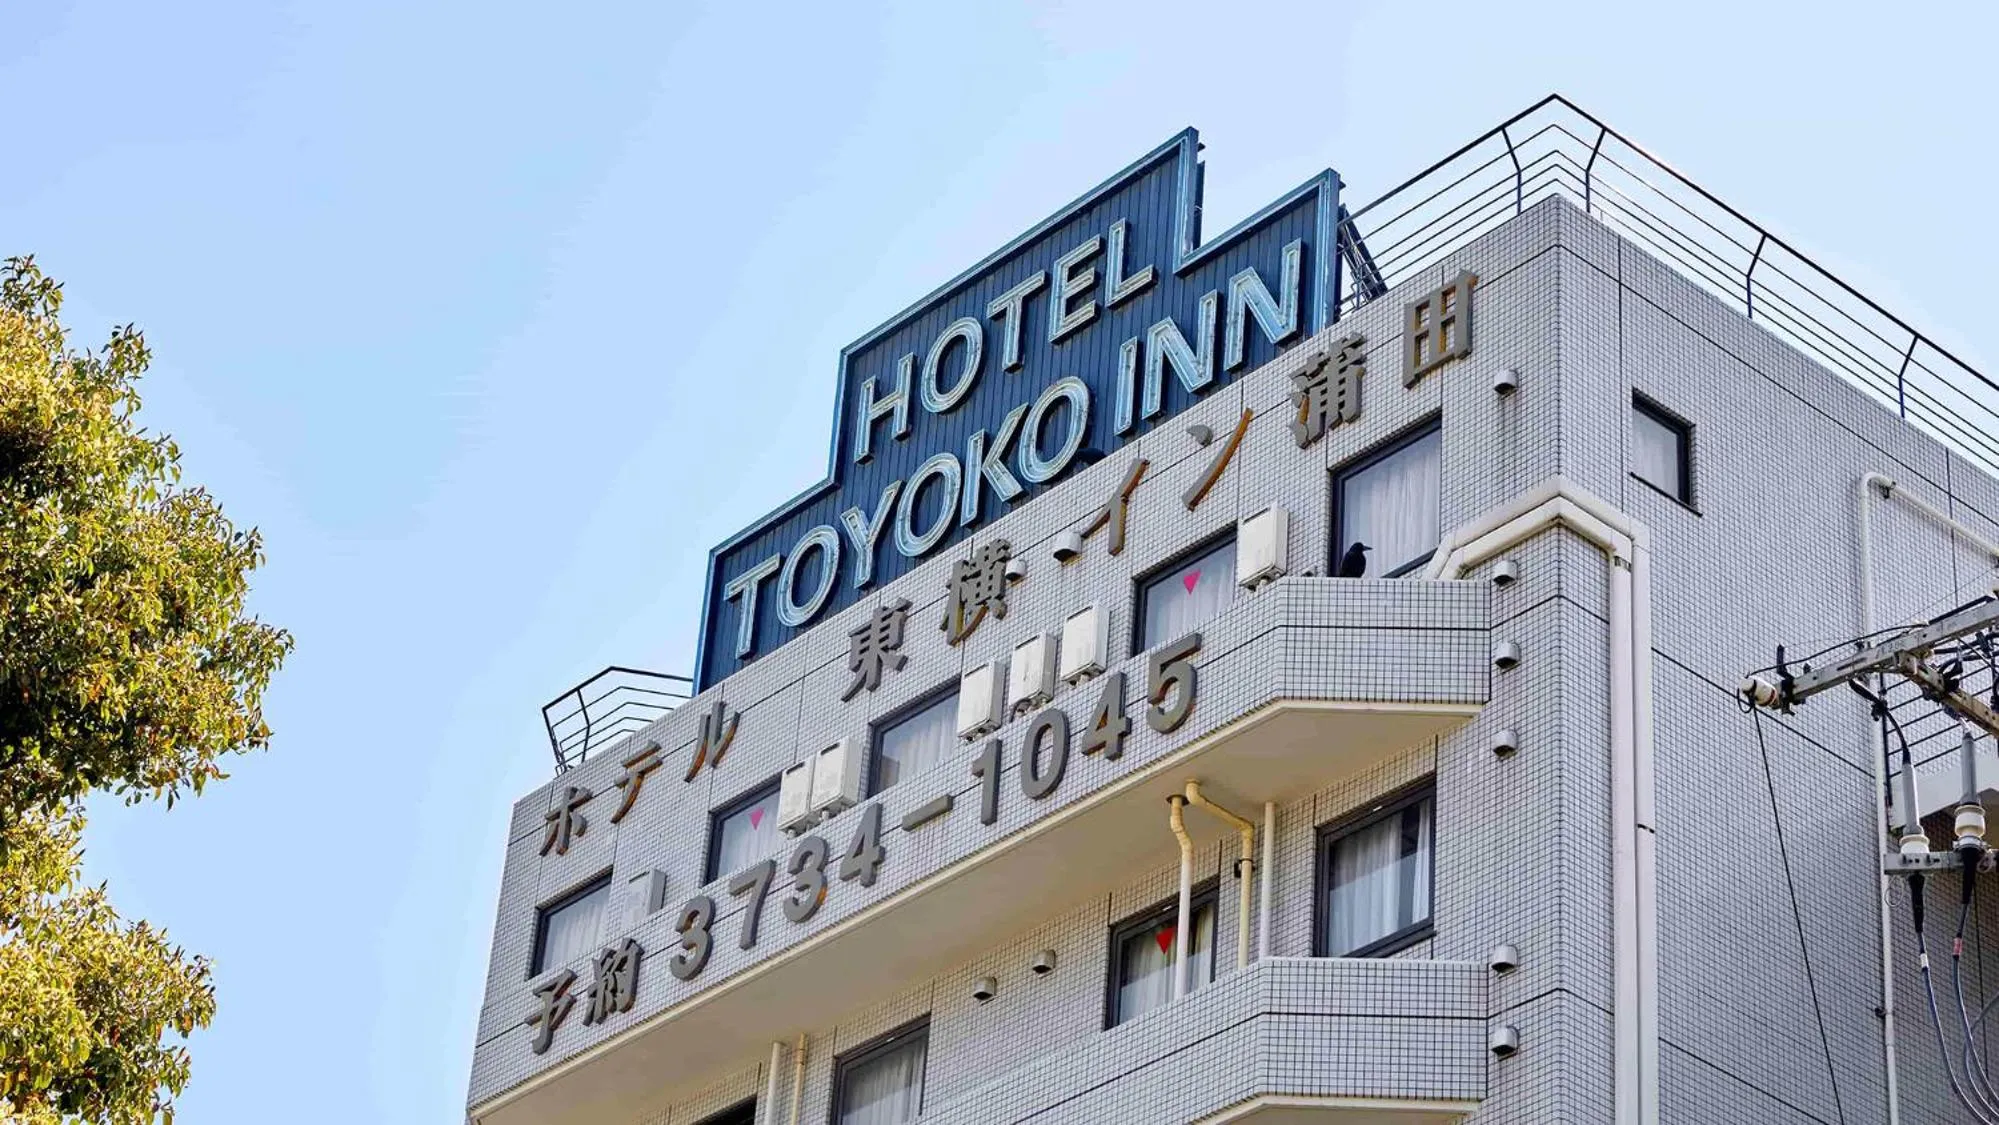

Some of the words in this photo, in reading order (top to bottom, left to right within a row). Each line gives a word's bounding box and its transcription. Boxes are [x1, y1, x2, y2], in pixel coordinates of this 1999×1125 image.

[853, 217, 1156, 464] HOTEL
[723, 376, 1092, 659] TOYOKO
[1113, 238, 1301, 436] INN
[539, 701, 740, 857] ホテル
[526, 937, 644, 1055] 予約
